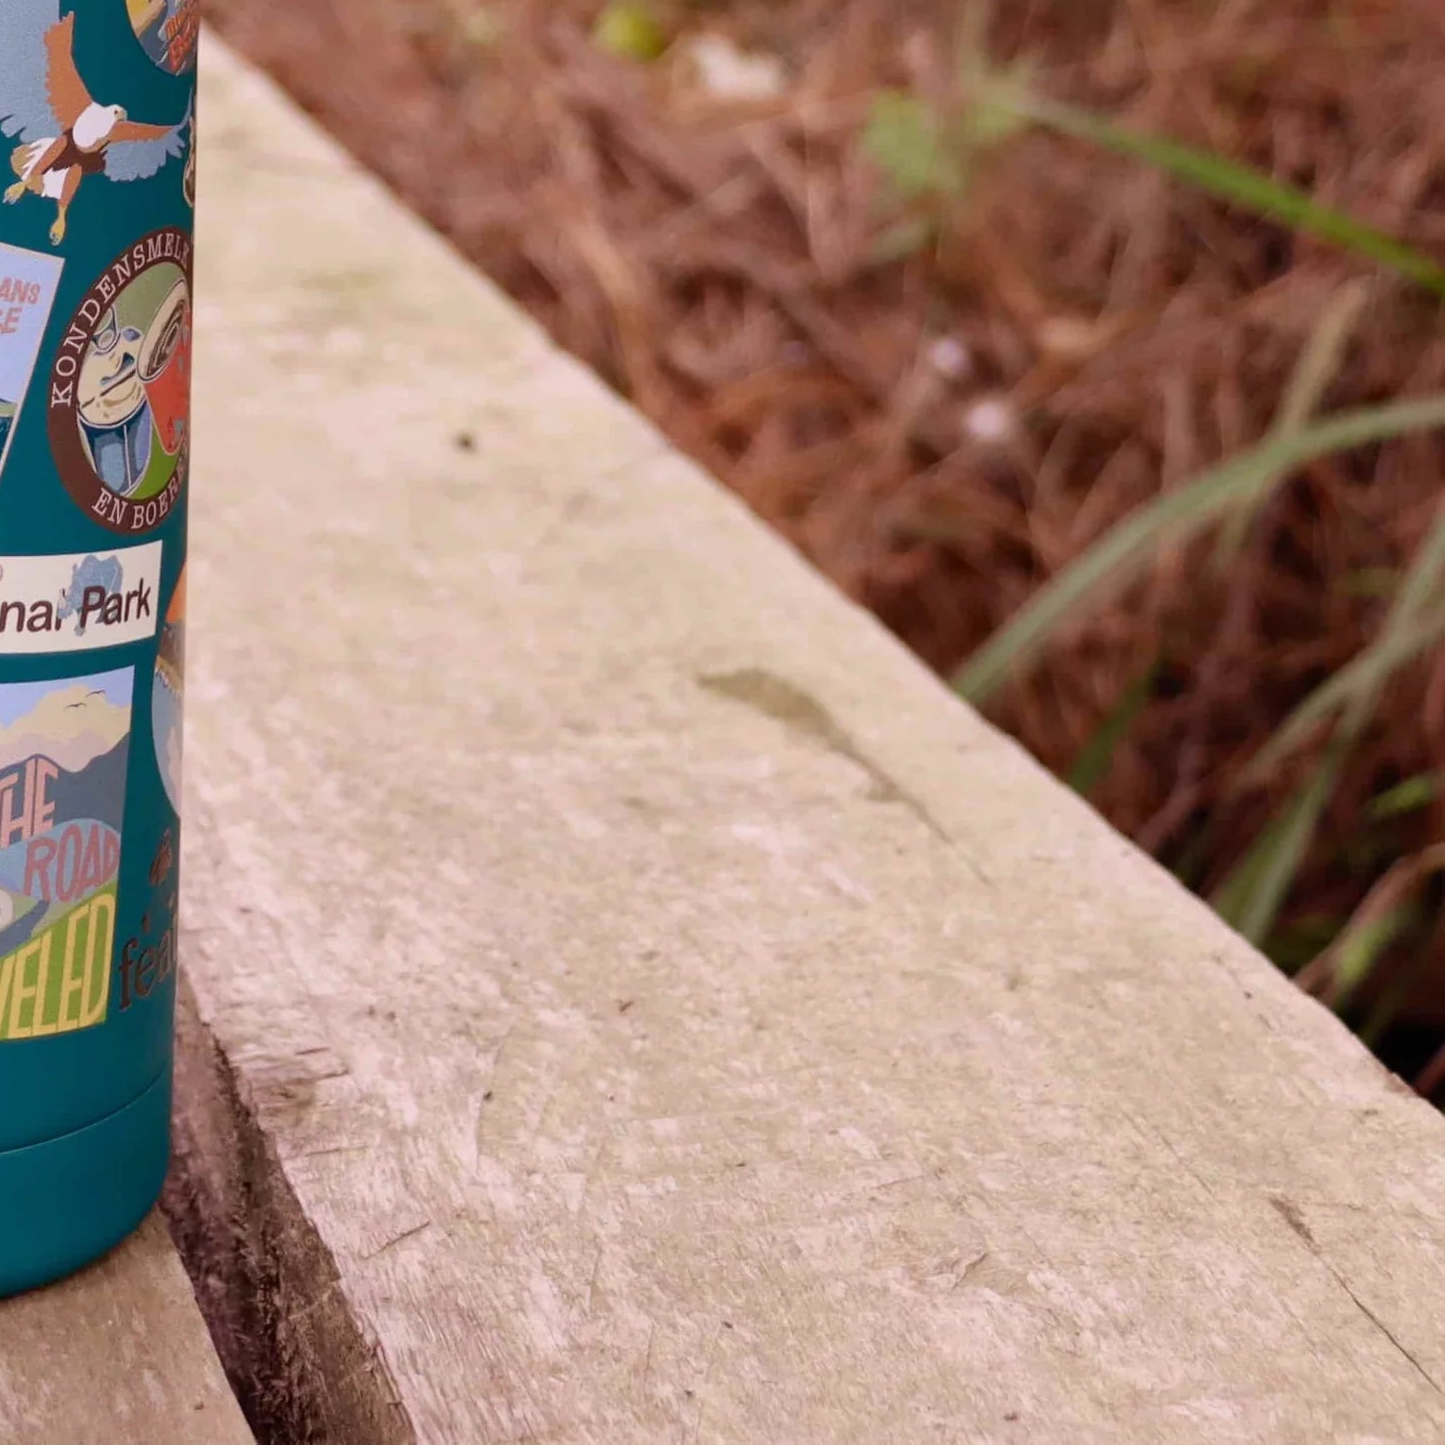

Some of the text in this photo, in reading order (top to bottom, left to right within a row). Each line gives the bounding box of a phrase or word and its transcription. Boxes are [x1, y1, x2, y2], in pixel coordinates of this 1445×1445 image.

[91, 487, 128, 526] EN
[79, 567, 152, 628] Park
[22, 824, 120, 903] ROAD
